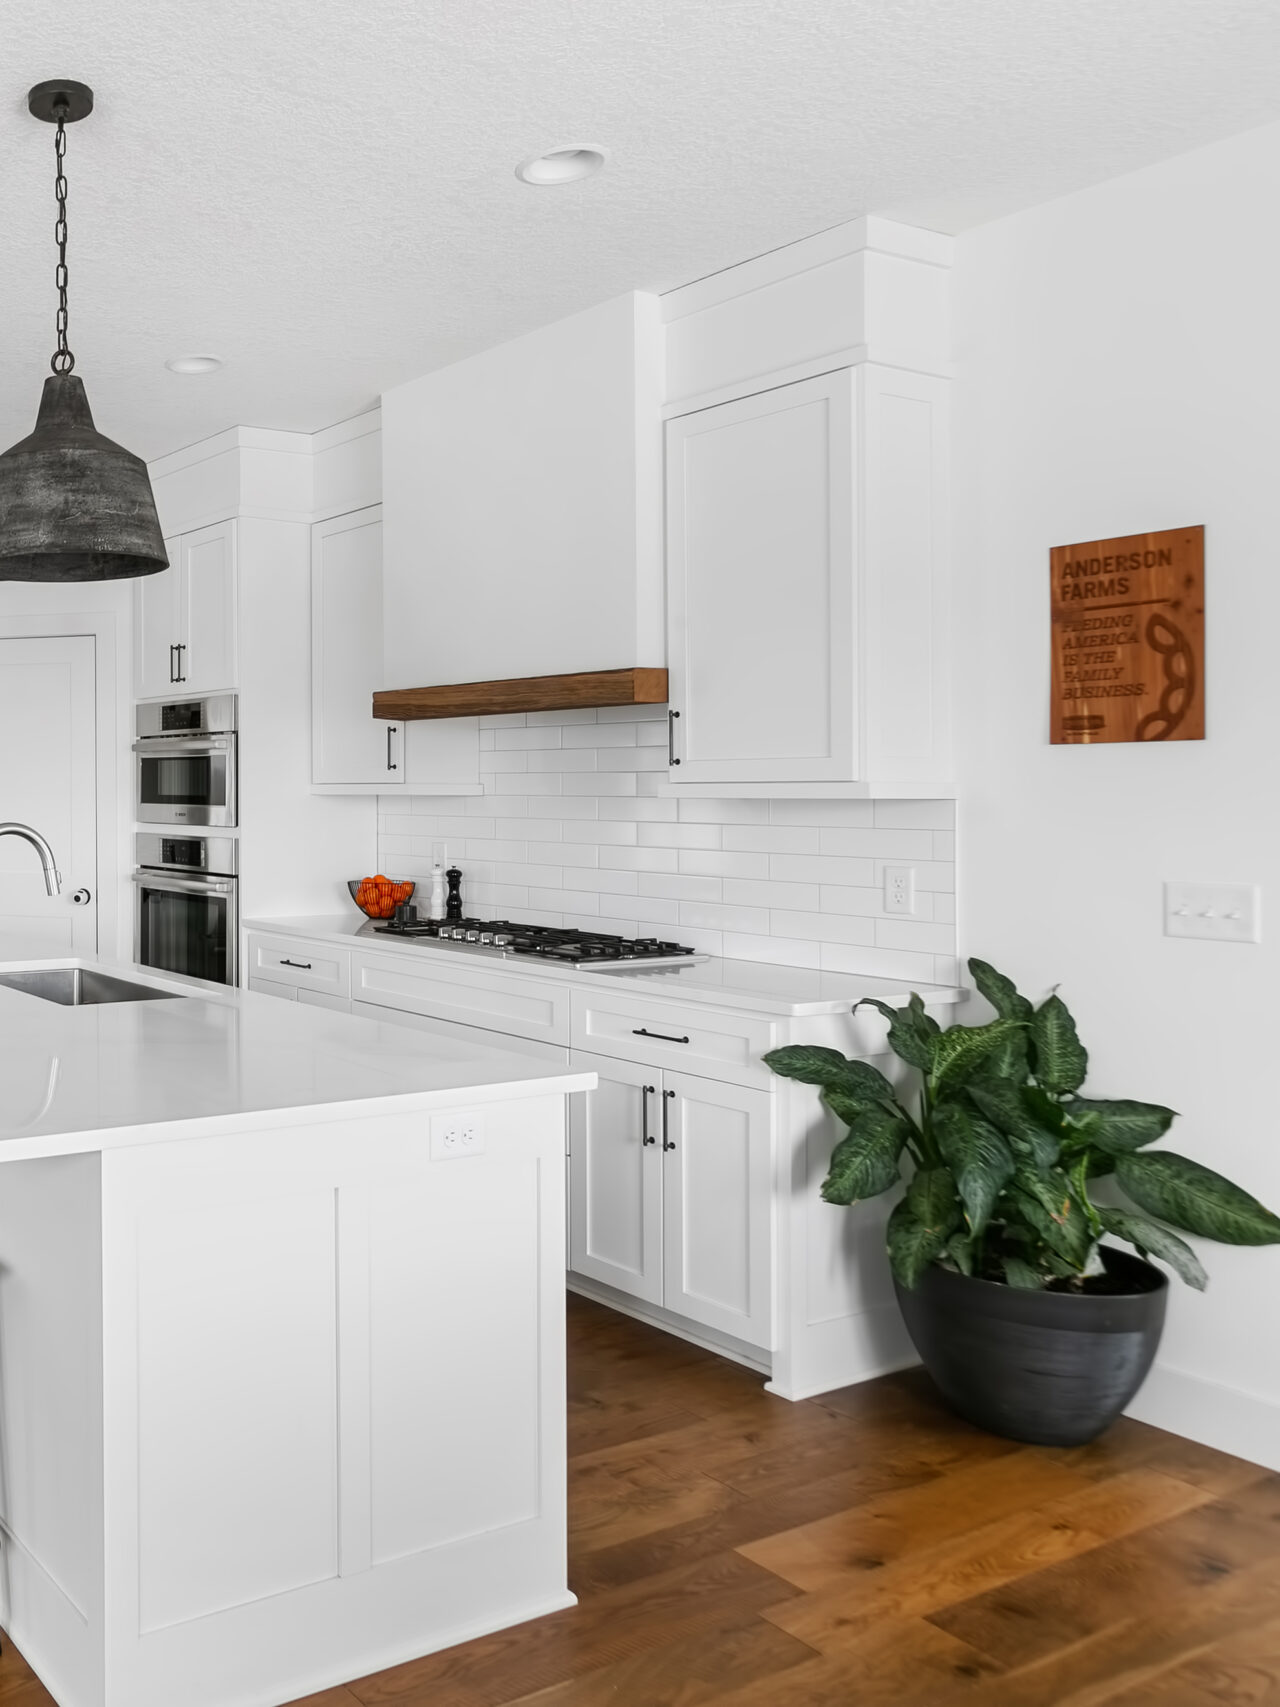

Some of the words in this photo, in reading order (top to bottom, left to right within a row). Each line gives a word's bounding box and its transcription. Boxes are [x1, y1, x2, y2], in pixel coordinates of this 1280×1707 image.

[1061, 547, 1172, 579] ANDERSON
[1061, 577, 1130, 602] FARMS
[1062, 614, 1134, 632] FEEDING
[1062, 631, 1140, 650] AMERICA
[1063, 653, 1079, 666] IS
[1083, 651, 1116, 665] THE
[1062, 667, 1125, 683] FAMILY
[1062, 682, 1149, 700] BUSINESS.
